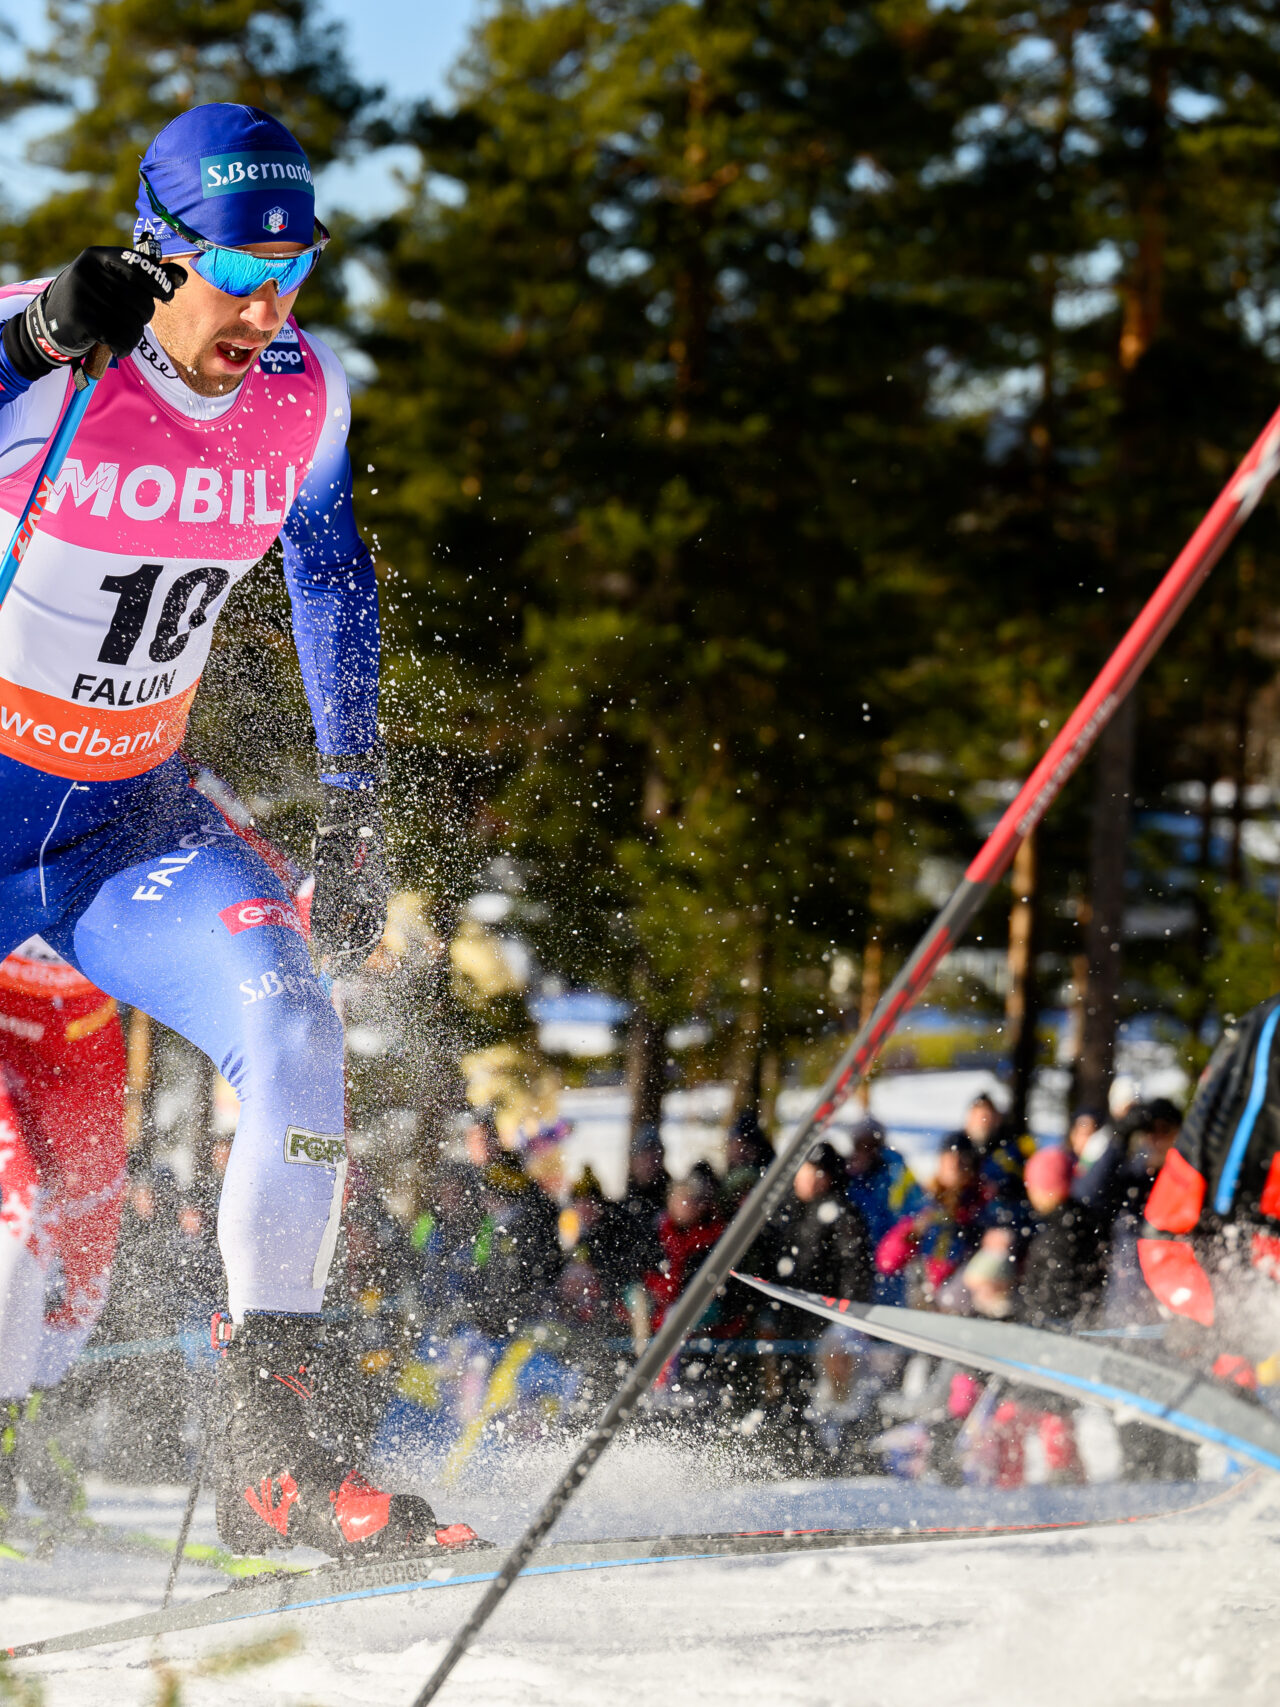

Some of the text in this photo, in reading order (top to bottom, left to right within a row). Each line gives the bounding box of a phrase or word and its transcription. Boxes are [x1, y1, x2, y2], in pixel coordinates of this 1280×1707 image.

[260, 350, 301, 365] coop
[96, 563, 231, 666] 10
[71, 668, 177, 706] FALUN
